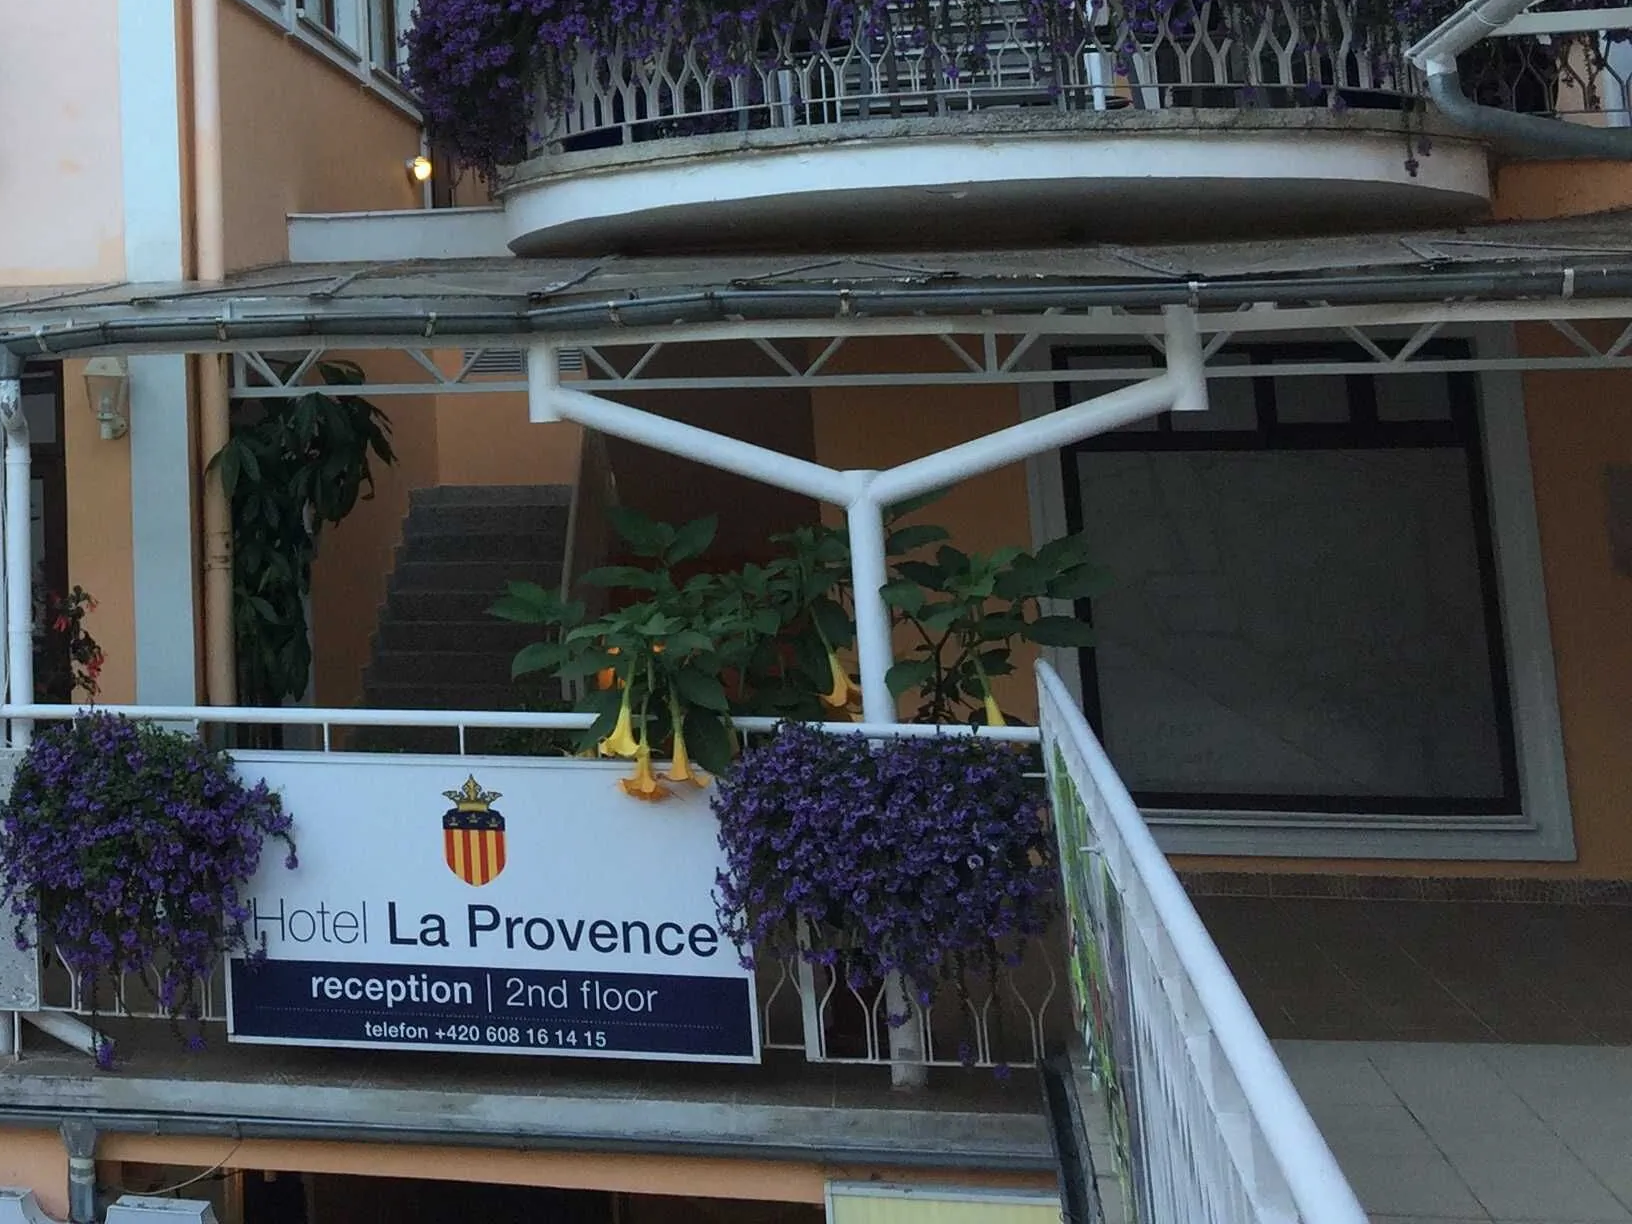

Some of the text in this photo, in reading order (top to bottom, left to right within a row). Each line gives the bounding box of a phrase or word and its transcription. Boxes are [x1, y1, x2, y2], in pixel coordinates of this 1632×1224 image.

[252, 897, 719, 958] Hotel La Provence
[311, 974, 659, 1013] reception 2nd floor
[365, 1021, 607, 1048] telefon +420 608 16 14 15
